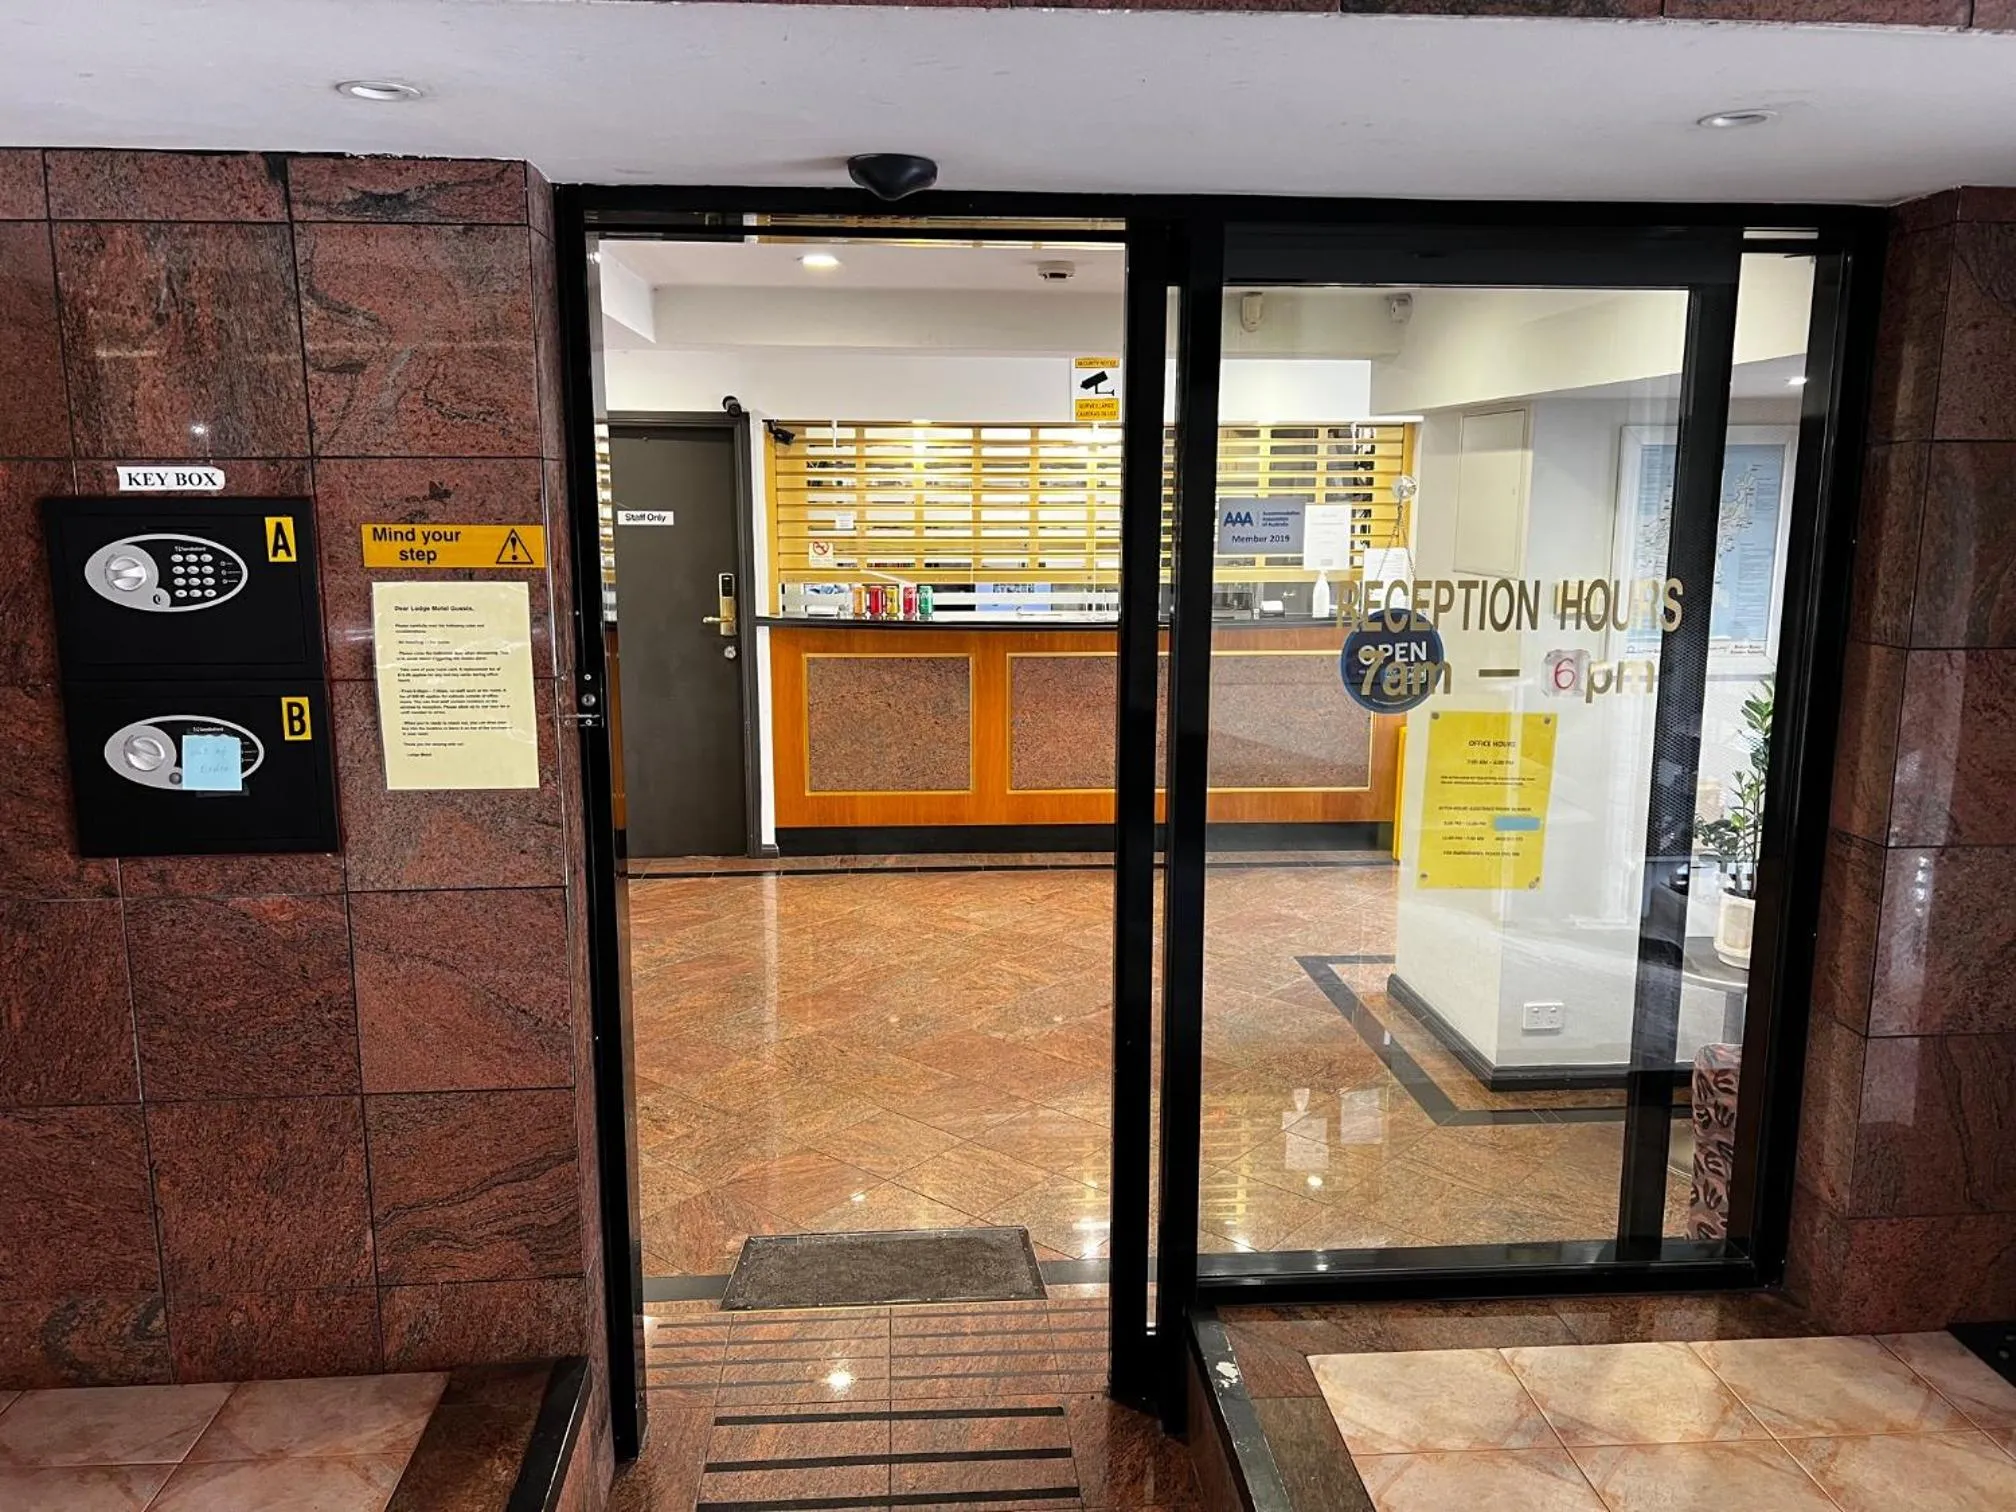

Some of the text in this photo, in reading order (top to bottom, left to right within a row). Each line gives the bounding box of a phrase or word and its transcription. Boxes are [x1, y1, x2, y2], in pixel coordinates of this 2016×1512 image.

[127, 472, 218, 487] KEY BOX
[624, 512, 667, 523] Staff Only
[1223, 511, 1254, 527] AAA
[271, 521, 293, 558] A
[371, 526, 462, 546] Mind your
[1231, 534, 1291, 544] Member 2019
[399, 548, 438, 565] step
[1335, 579, 1541, 633] RECEPTION
[1559, 577, 1685, 633] HOURS
[1358, 640, 1428, 666] OPEN
[1358, 650, 1451, 697] 7am
[287, 701, 307, 738] B
